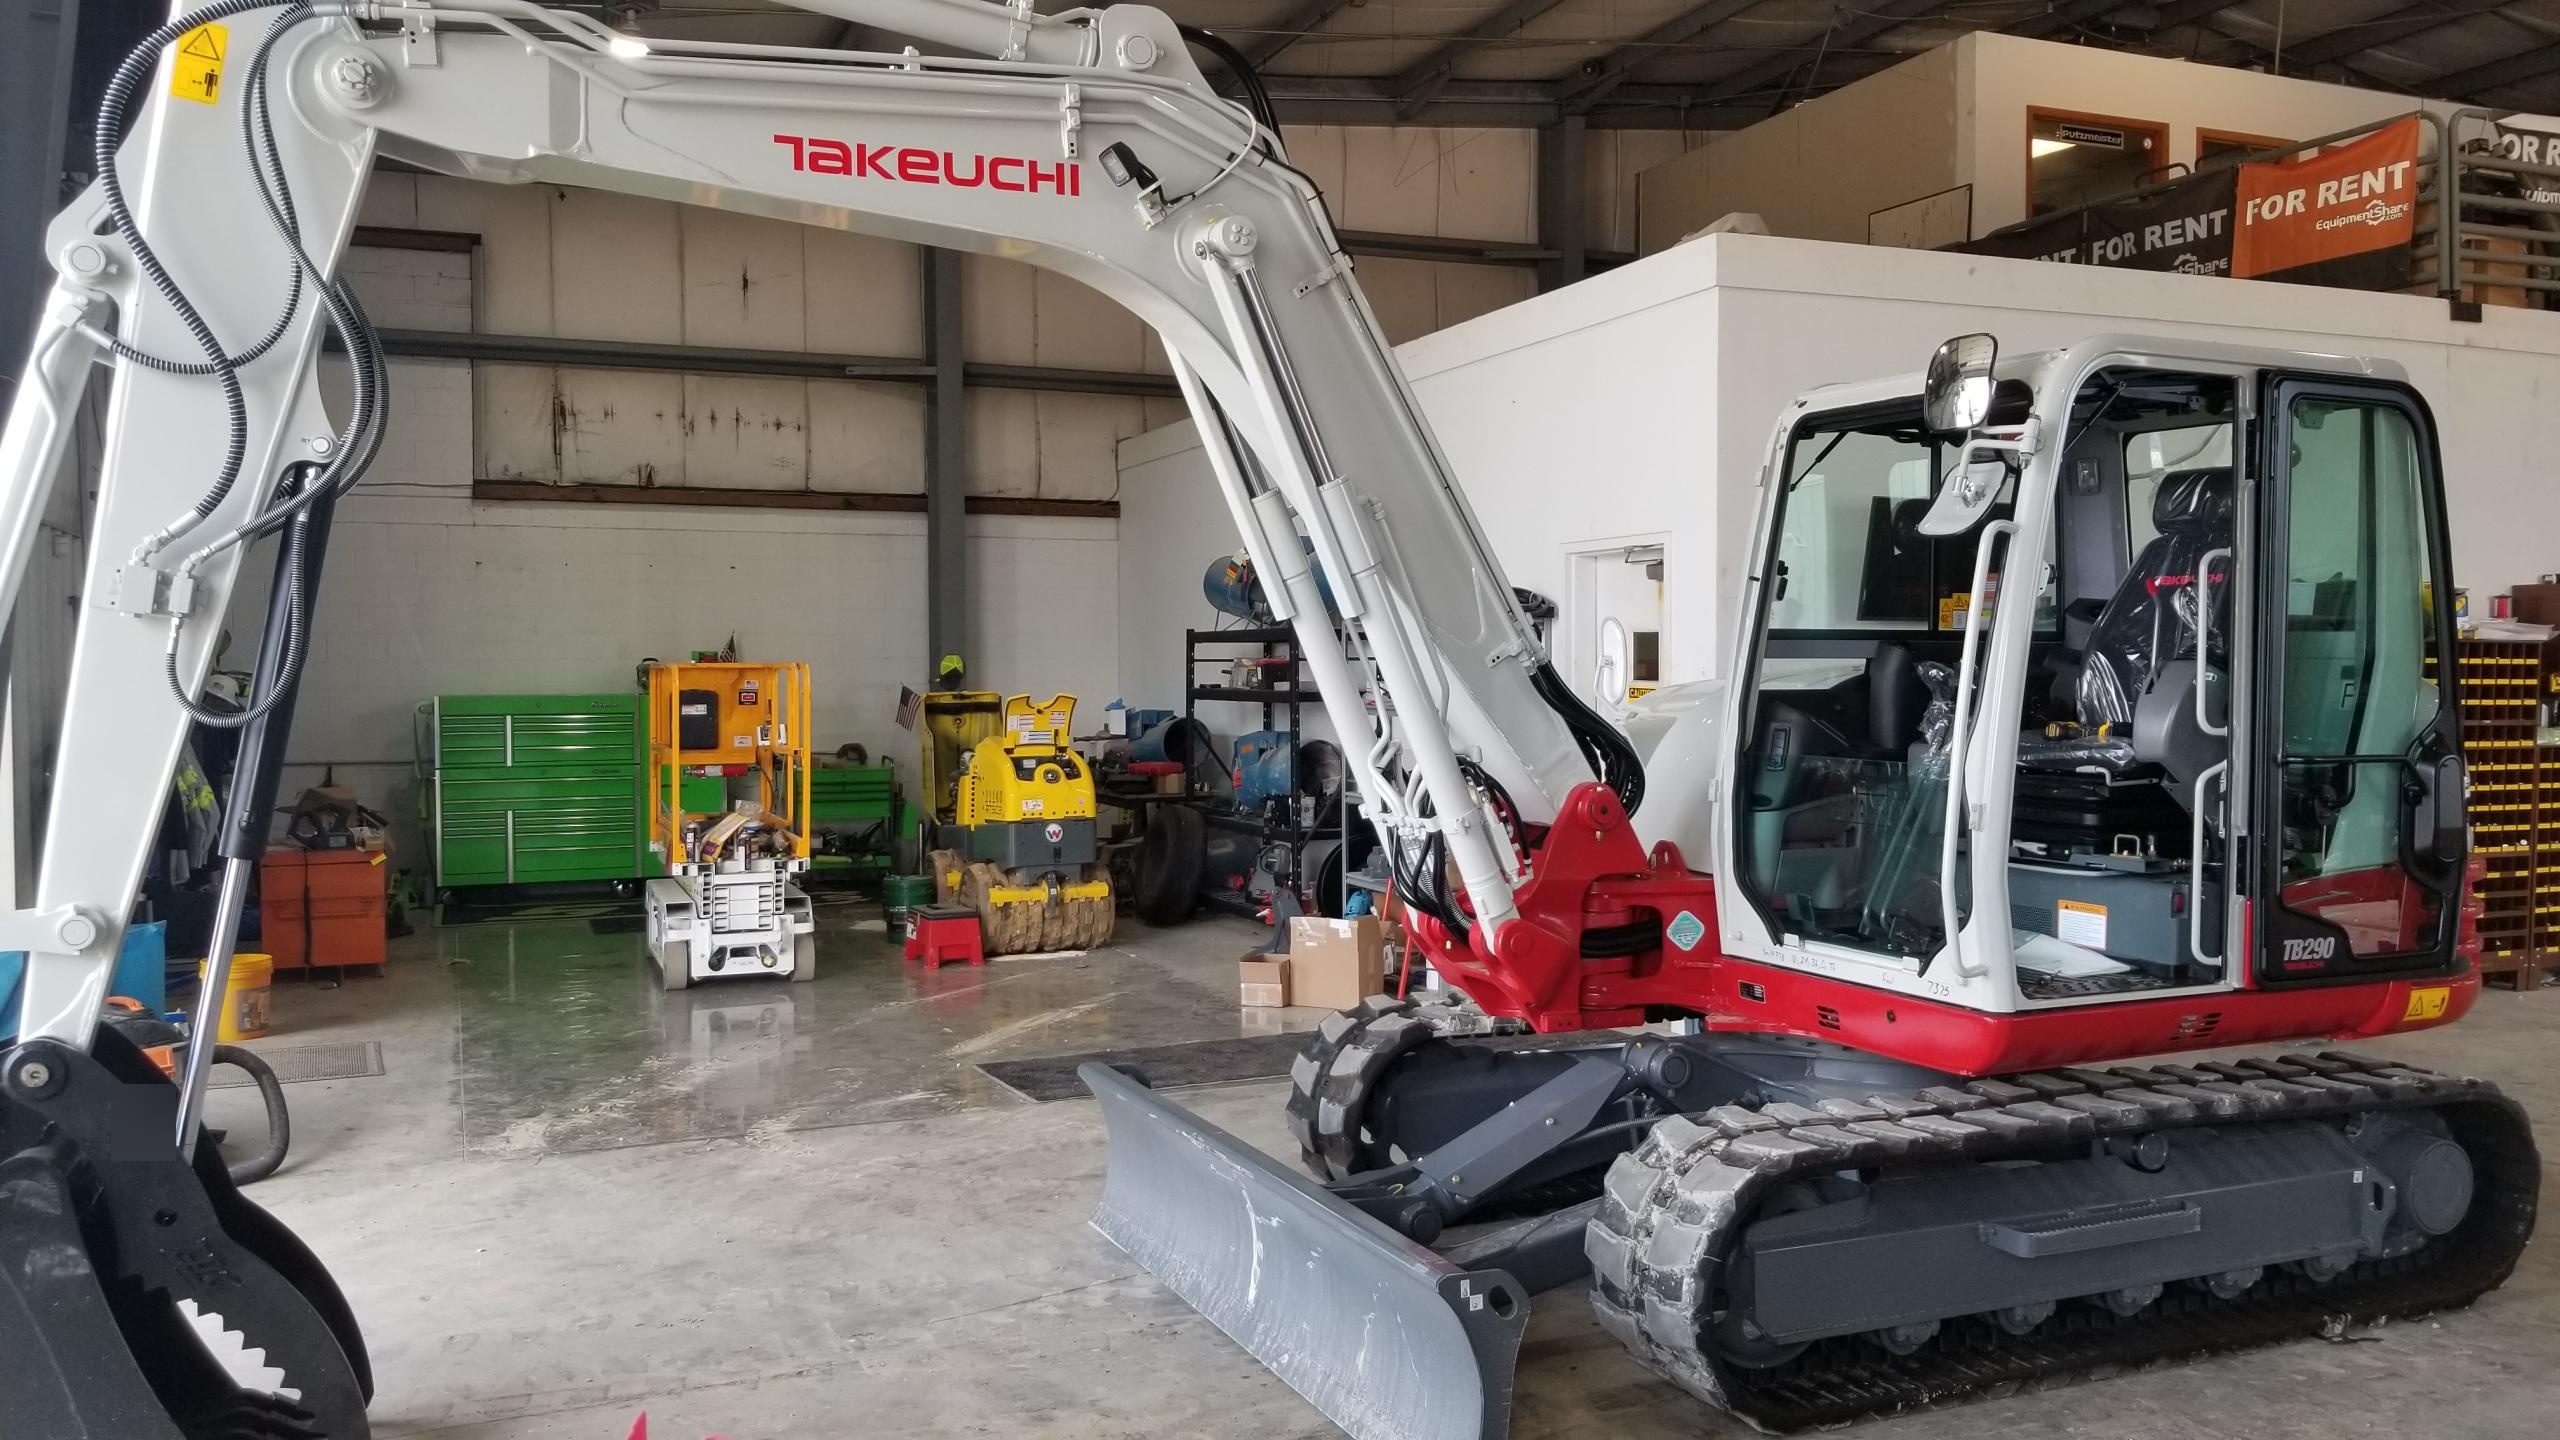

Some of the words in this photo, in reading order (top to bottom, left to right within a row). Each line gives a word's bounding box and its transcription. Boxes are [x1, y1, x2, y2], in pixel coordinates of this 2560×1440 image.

[2500, 133, 2540, 164] OR
[2246, 188, 2306, 226] FOR
[2317, 160, 2411, 209] RENT
[2316, 202, 2410, 231] EquipmentShare
[2092, 231, 2137, 265] FOR
[2144, 208, 2228, 251] RENT
[2283, 937, 2335, 960] TB290
